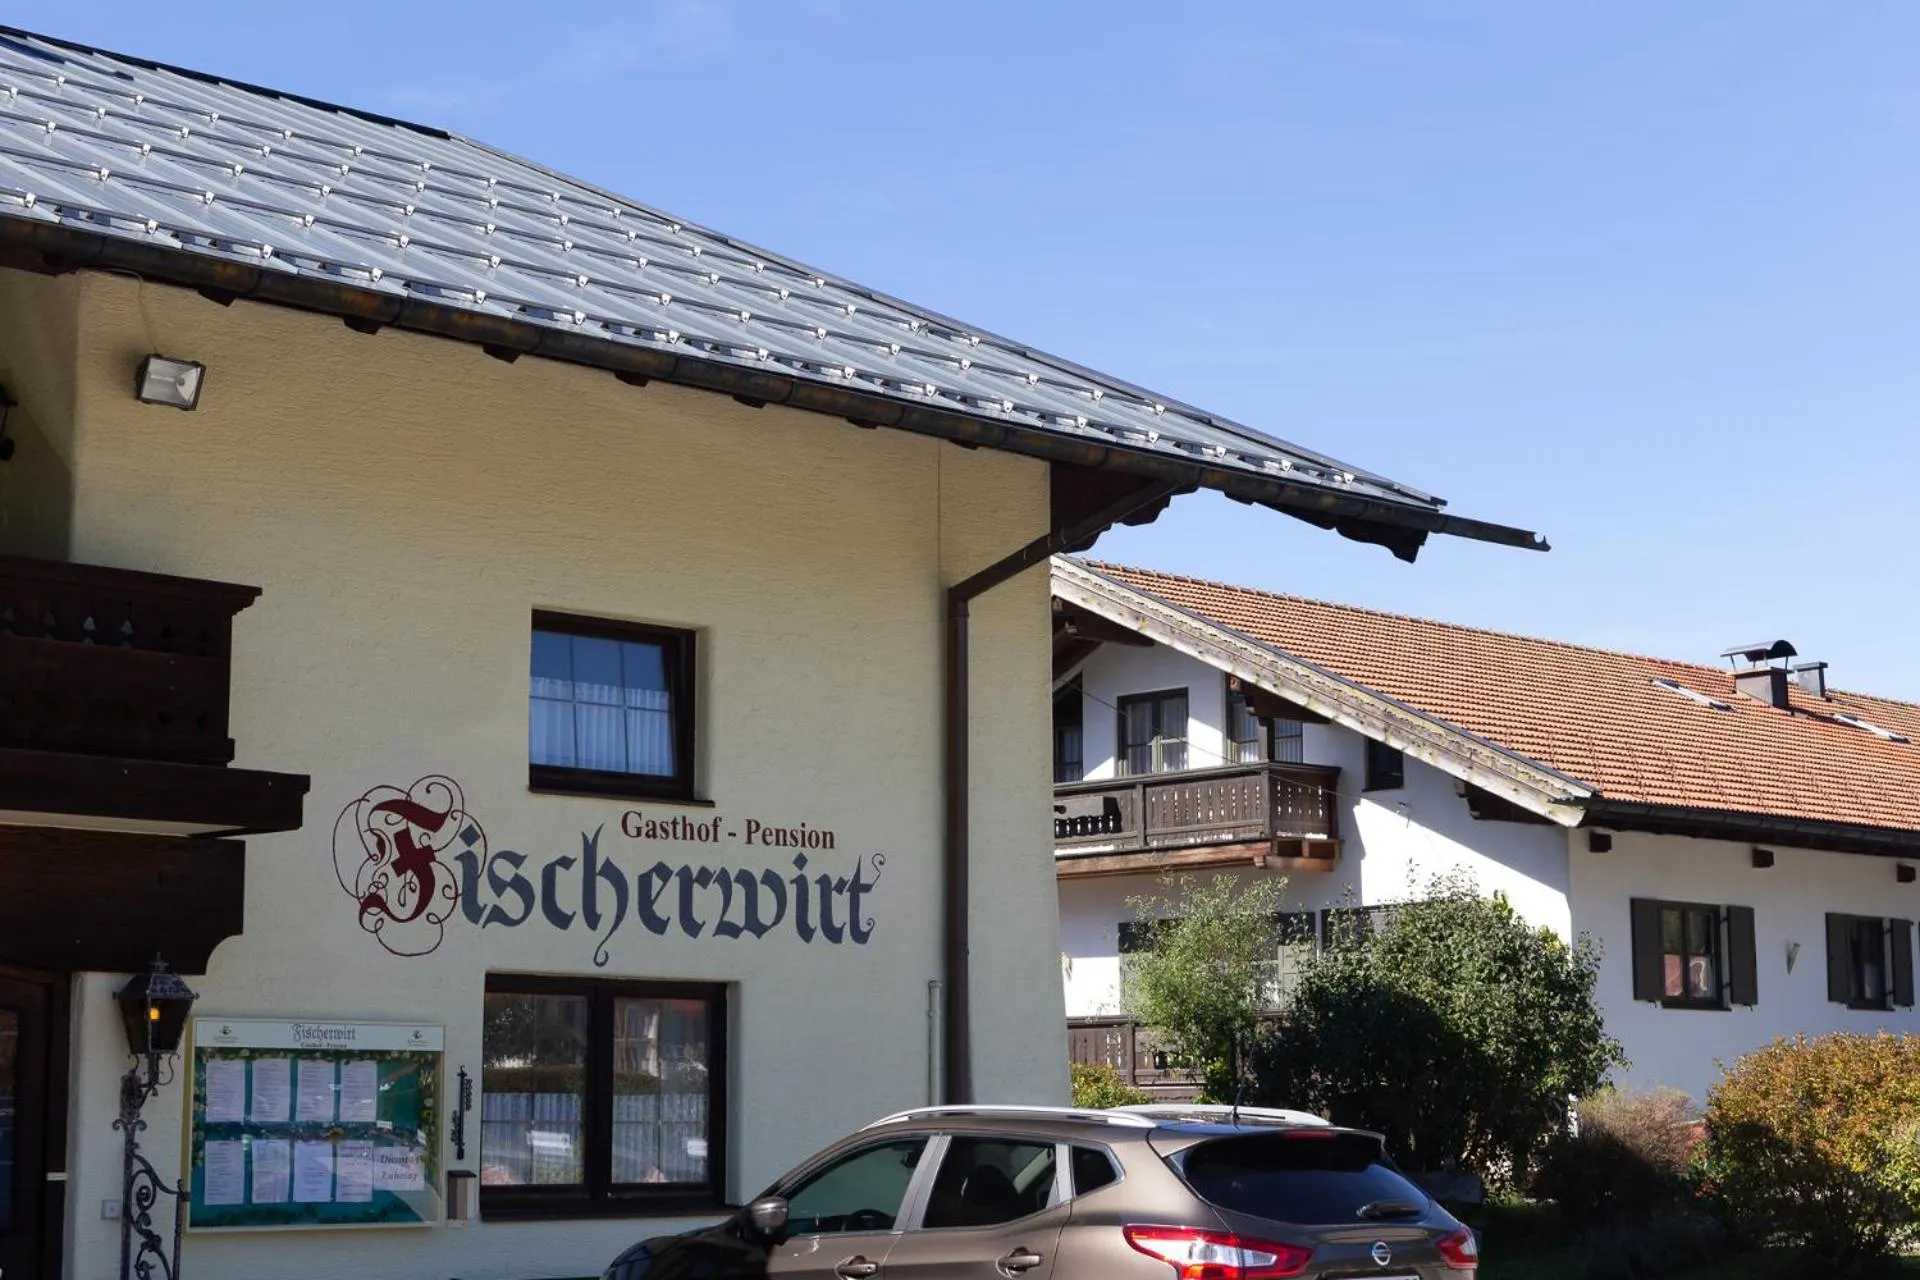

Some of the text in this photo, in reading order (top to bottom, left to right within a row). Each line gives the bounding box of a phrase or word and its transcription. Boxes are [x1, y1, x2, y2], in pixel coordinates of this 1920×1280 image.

[621, 810, 722, 842] Gasthof
[745, 819, 835, 849] Pension
[334, 774, 886, 967] Fischerwirt
[292, 1023, 356, 1042] Fischerwirt
